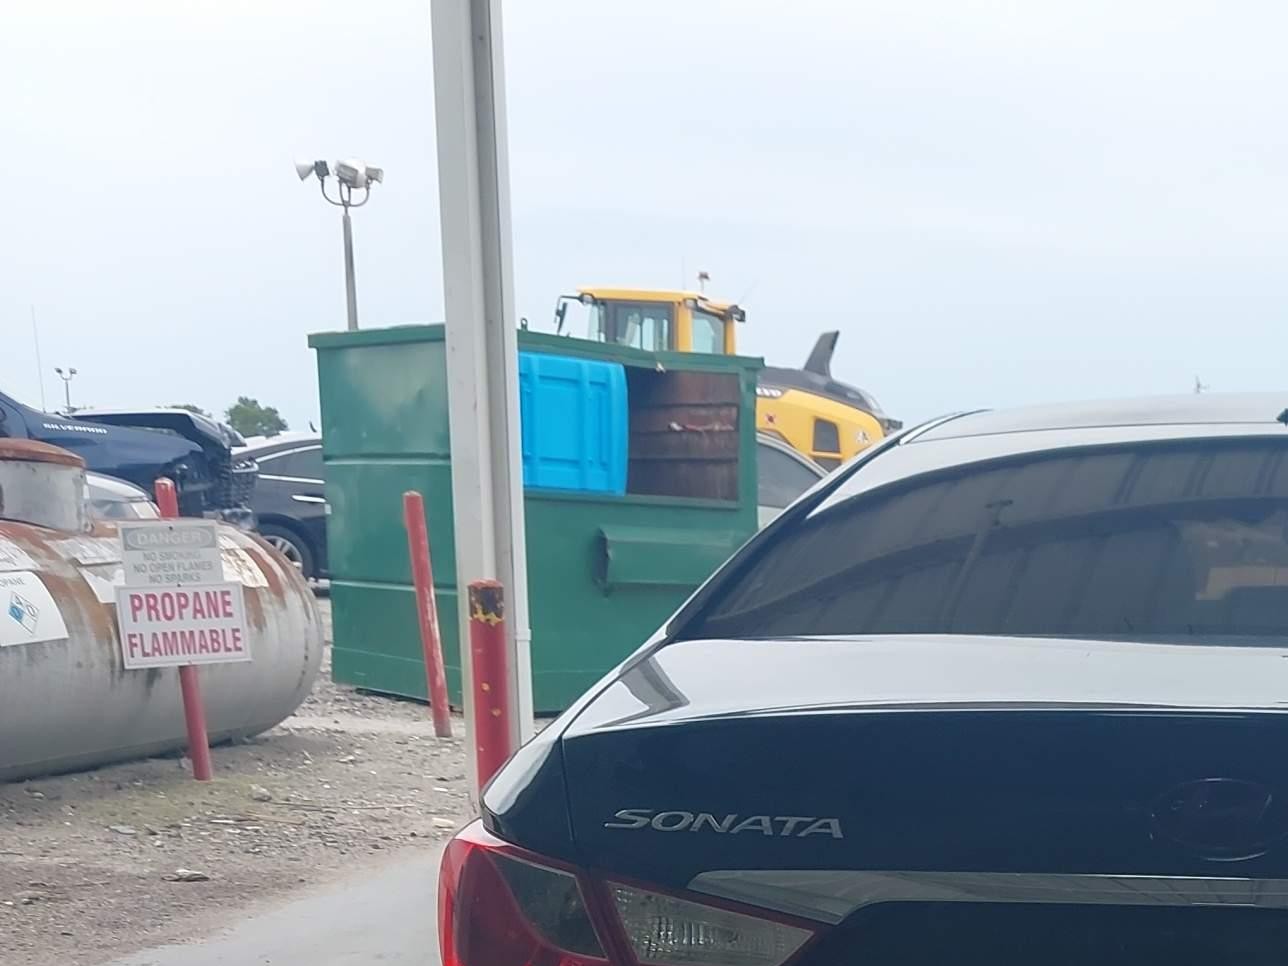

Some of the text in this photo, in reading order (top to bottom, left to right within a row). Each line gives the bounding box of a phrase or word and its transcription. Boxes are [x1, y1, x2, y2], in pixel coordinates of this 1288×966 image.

[137, 530, 201, 545] DANGER
[143, 551, 157, 561] NO
[133, 563, 147, 573] NO
[148, 574, 162, 584] NO
[129, 590, 233, 622] PROPANE
[127, 628, 243, 658] FLAMMABLE
[604, 809, 844, 838] SONATA
